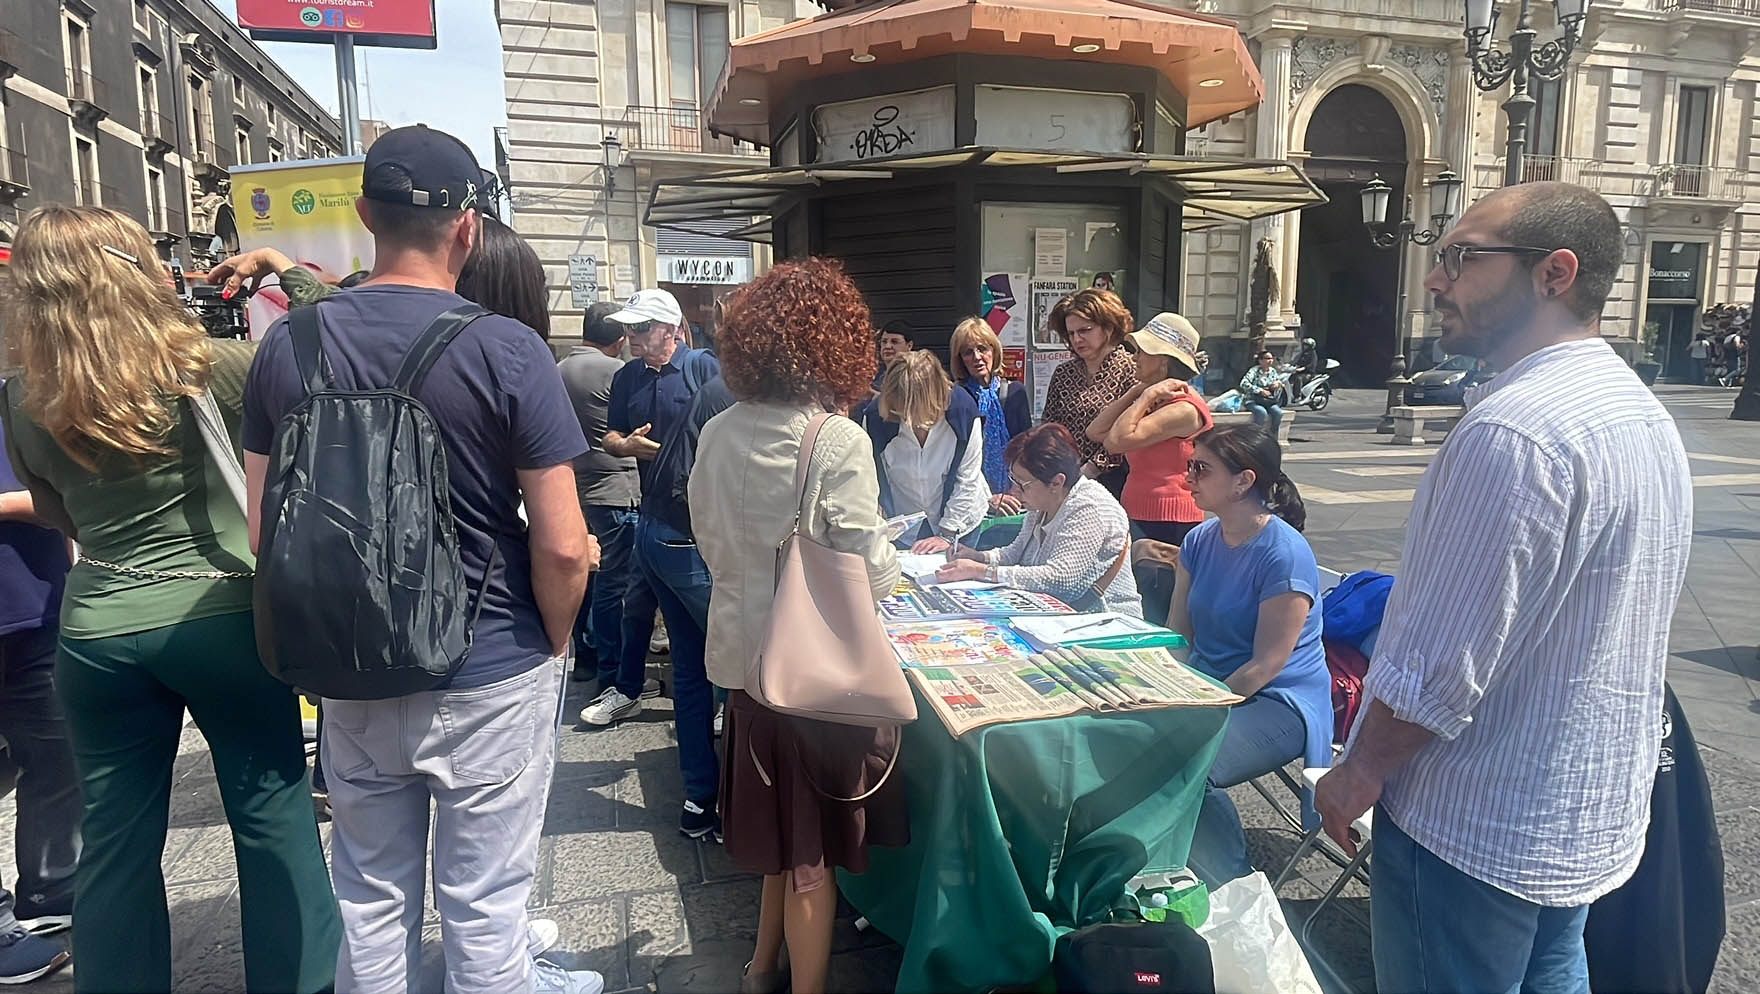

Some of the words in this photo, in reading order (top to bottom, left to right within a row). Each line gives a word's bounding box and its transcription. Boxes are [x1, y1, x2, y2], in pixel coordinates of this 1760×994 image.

[1047, 114, 1065, 142] 5
[320, 196, 350, 208] Marilù
[677, 259, 735, 277] WYCON
[1033, 281, 1056, 290] FANFARA
[1057, 281, 1078, 290] STATION
